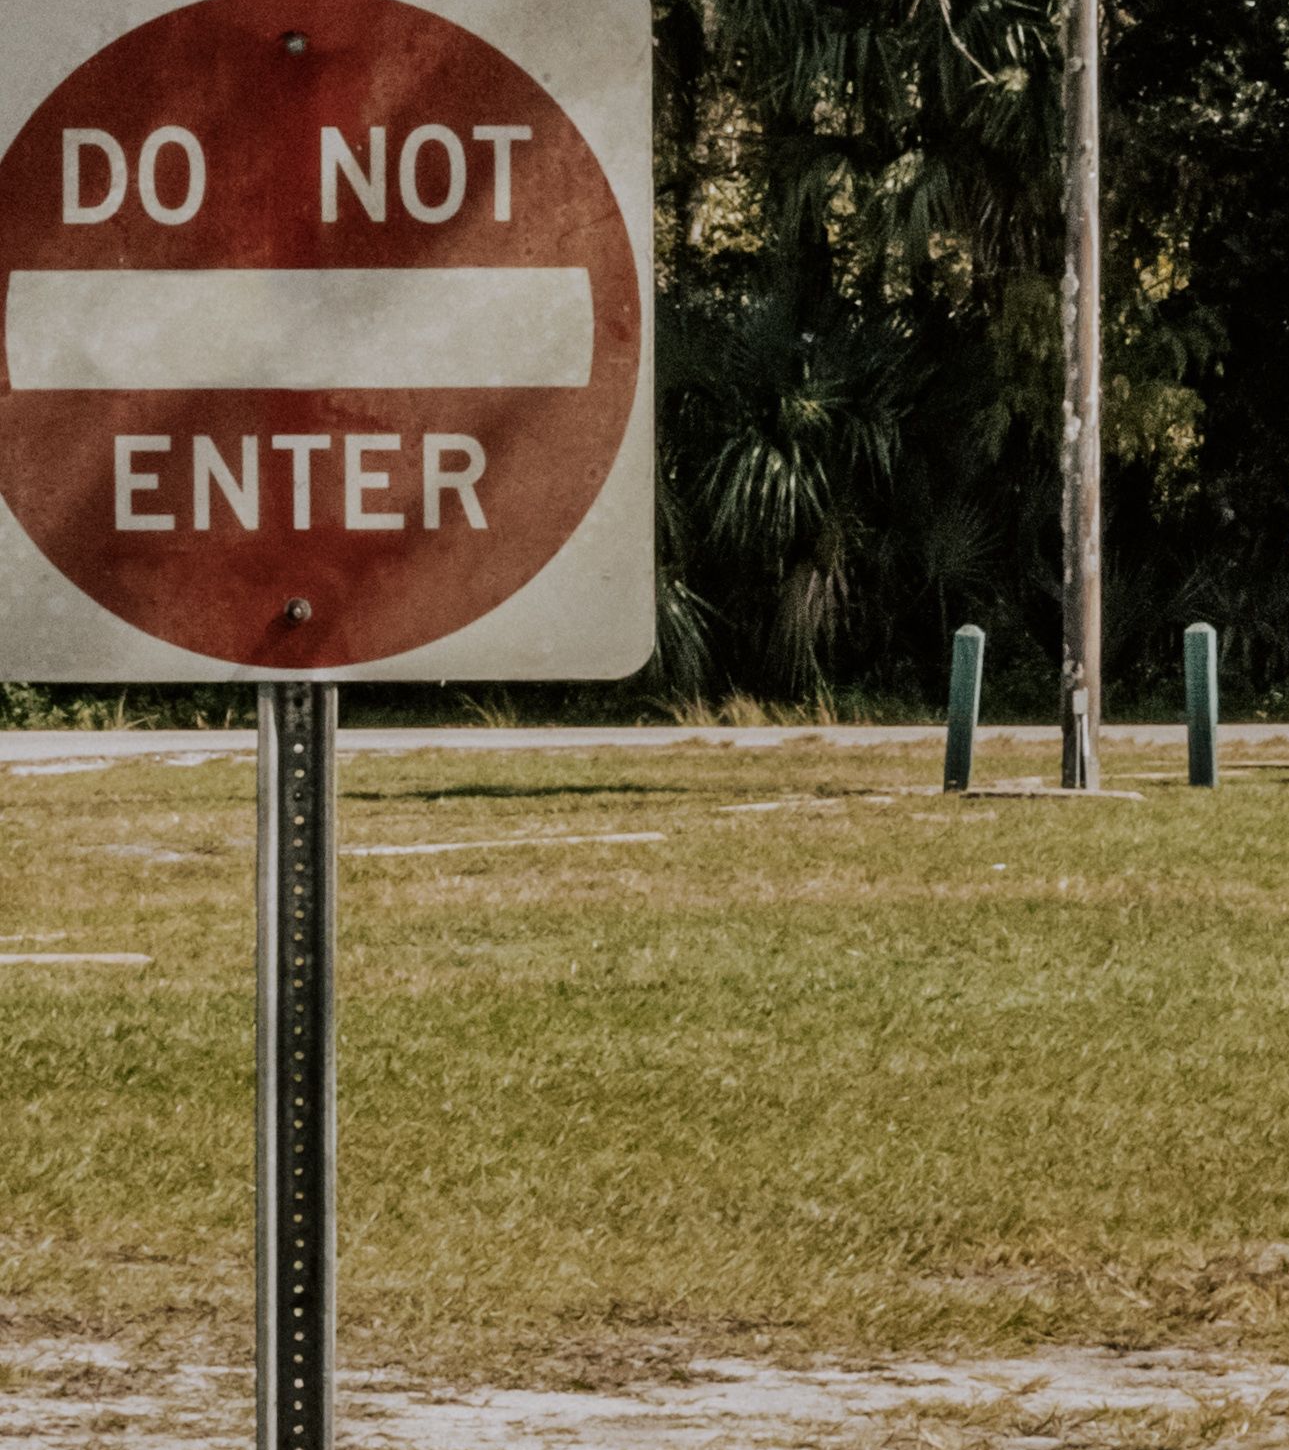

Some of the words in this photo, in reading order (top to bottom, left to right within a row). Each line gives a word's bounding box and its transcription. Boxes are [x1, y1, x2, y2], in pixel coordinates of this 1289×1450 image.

[61, 125, 207, 225] DO
[320, 124, 533, 224] NOT
[114, 433, 490, 531] ENTER
